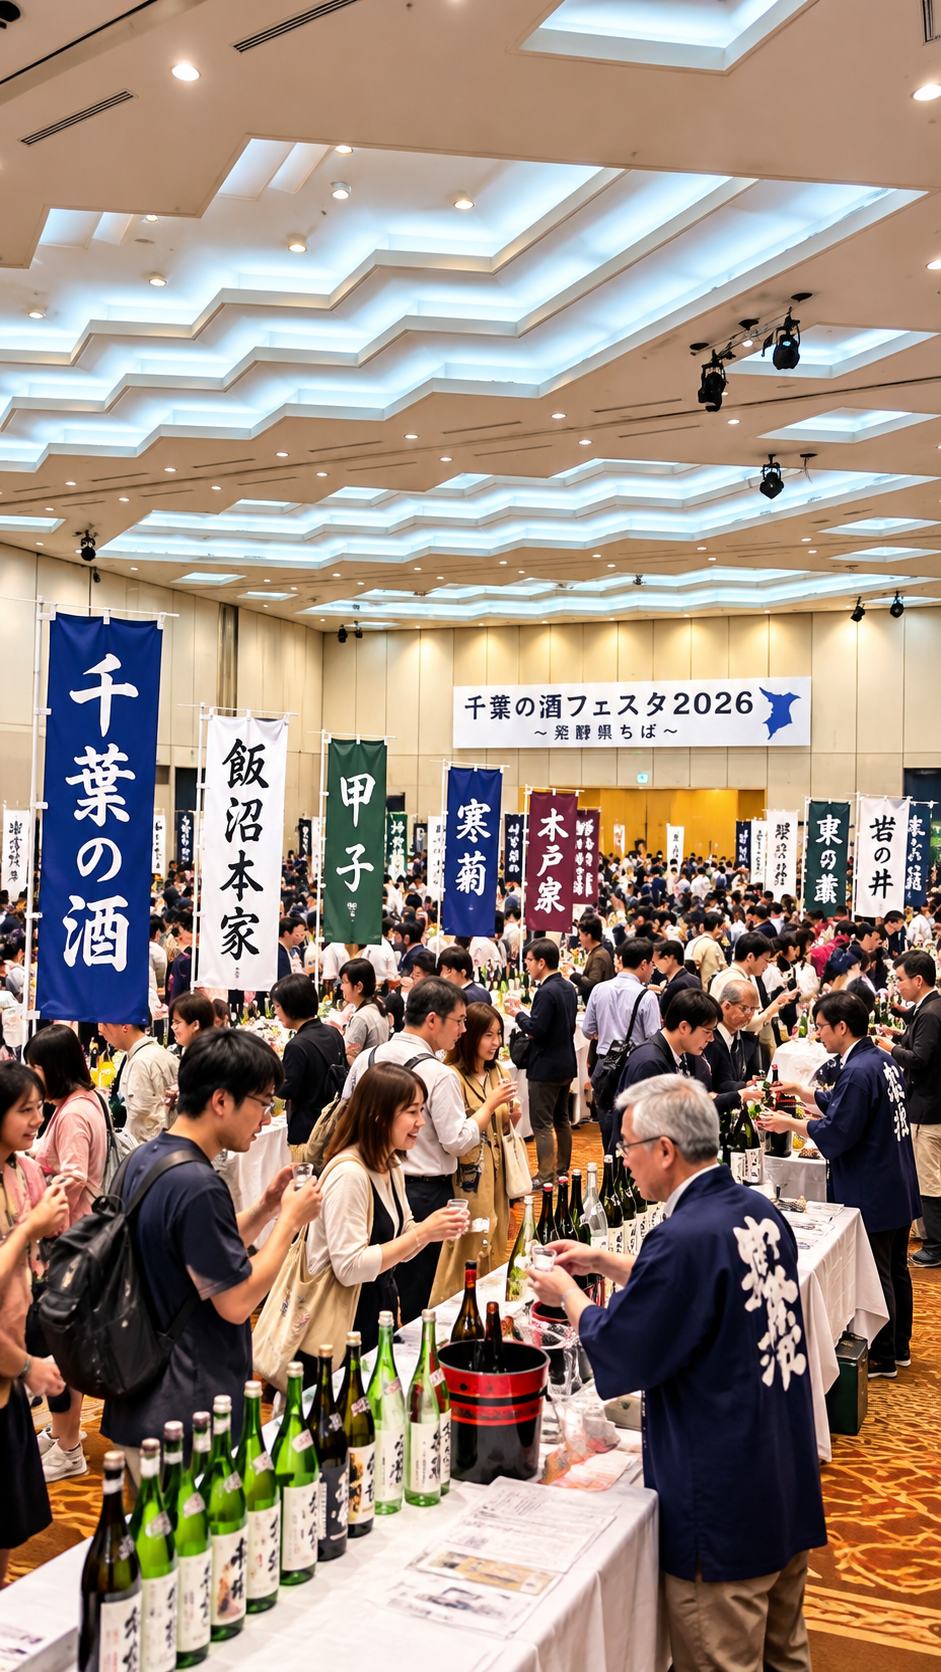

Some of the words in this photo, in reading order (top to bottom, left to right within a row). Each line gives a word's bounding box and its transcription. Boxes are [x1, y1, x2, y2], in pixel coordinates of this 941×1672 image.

[464, 690, 754, 720] 千葉の酒フェスタ2026
[62, 653, 139, 972] 千葉の酒
[218, 738, 270, 961] 飯沼本家
[336, 773, 376, 893] 甲子
[455, 798, 492, 897] 寒菊
